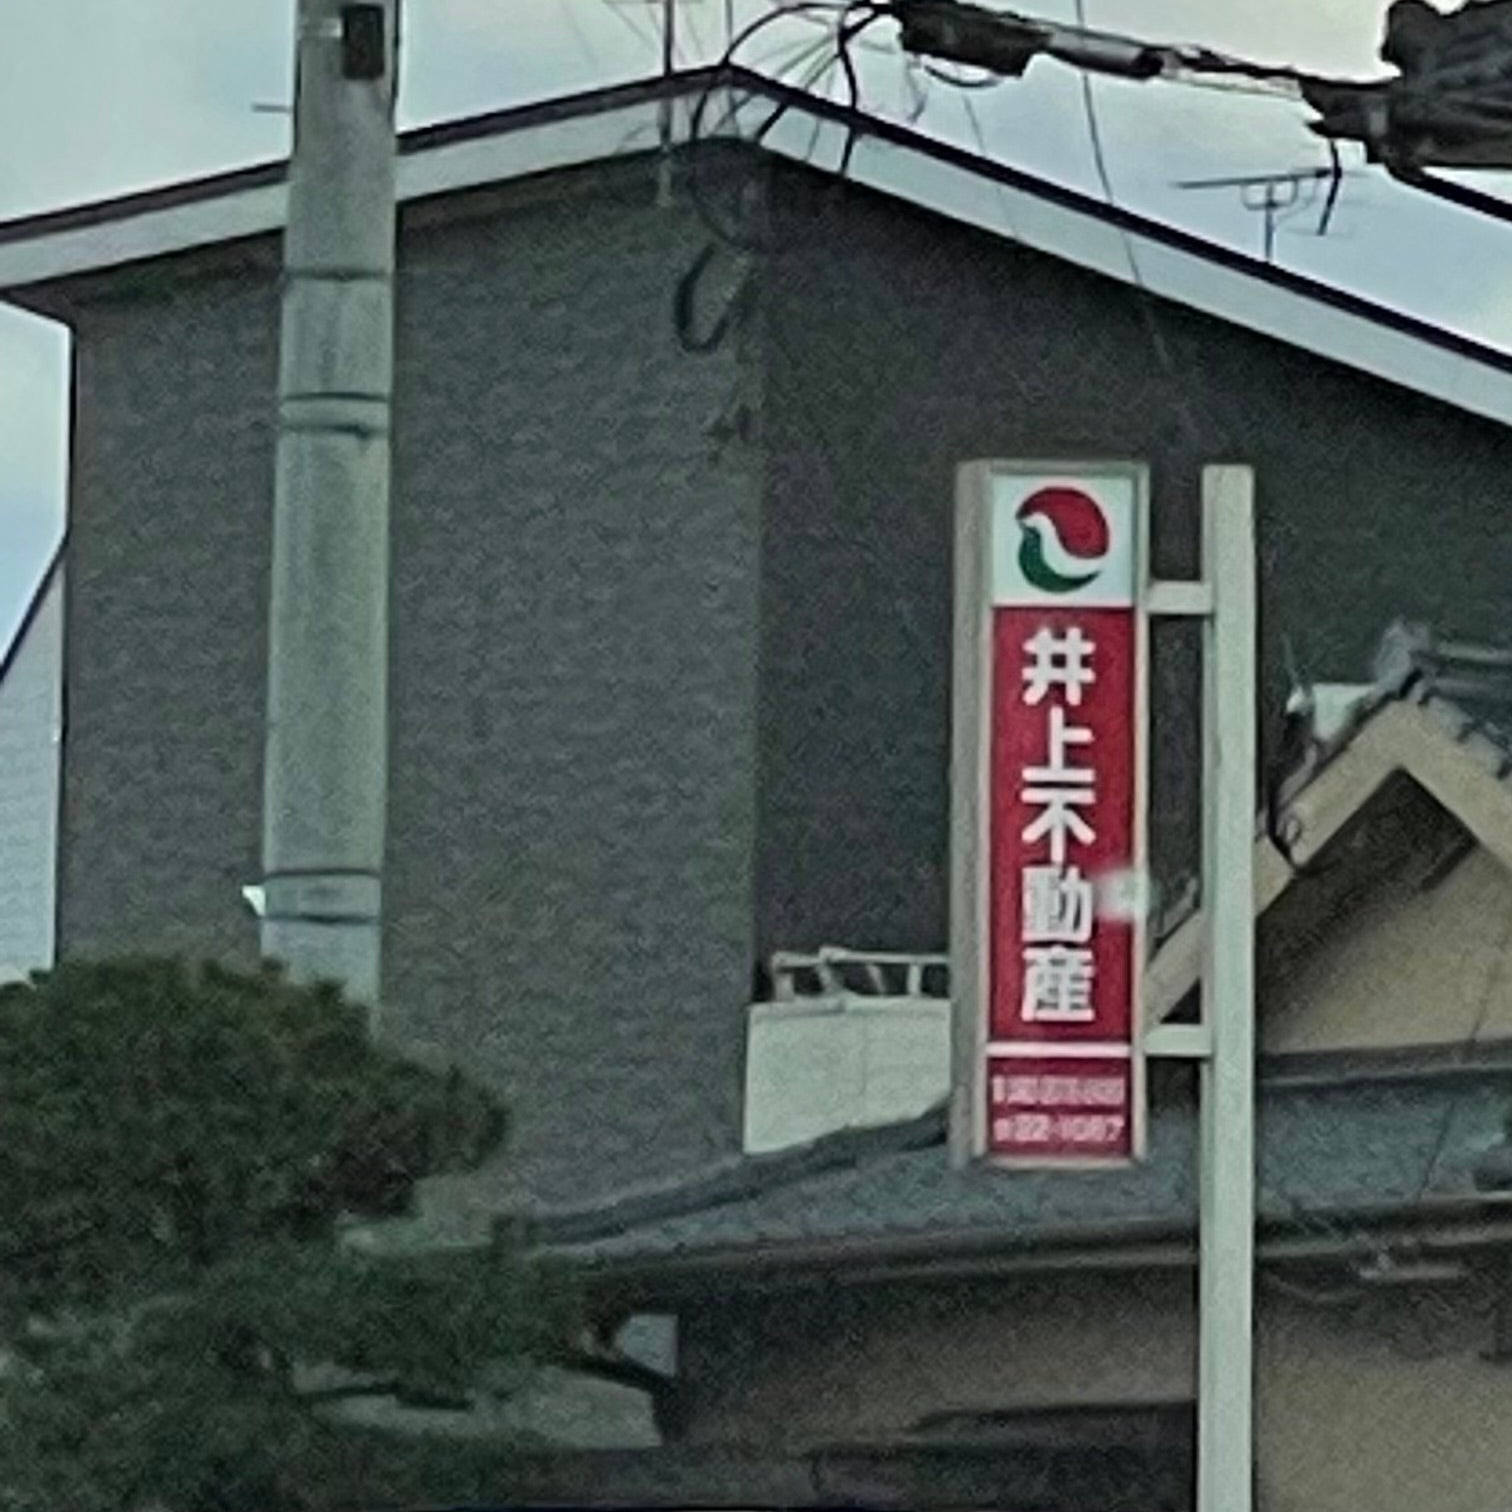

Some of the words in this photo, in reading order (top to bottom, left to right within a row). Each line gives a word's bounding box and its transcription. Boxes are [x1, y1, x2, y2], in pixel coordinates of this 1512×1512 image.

[1021, 626, 1096, 1022] 井上不動産
